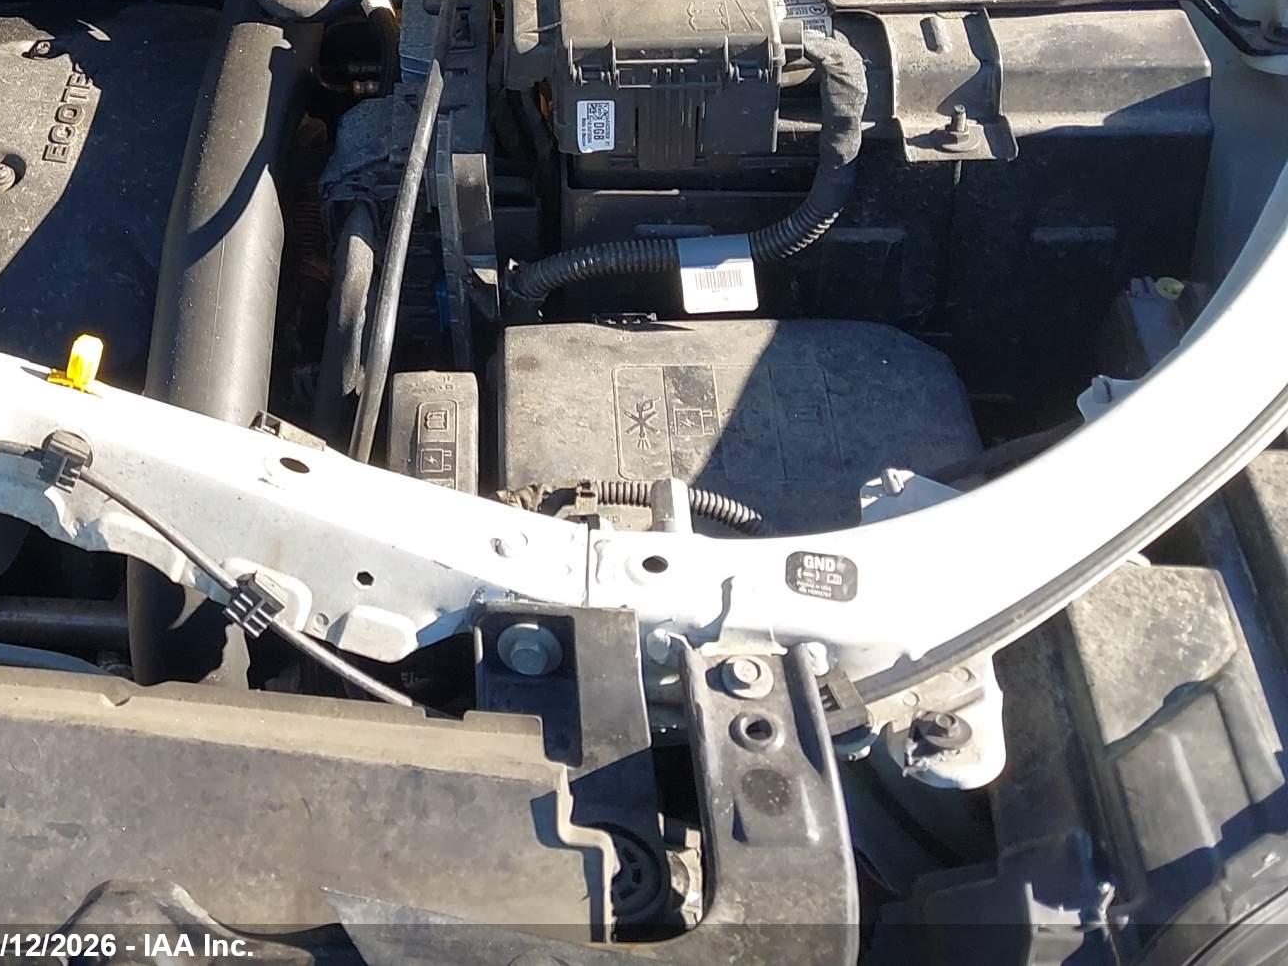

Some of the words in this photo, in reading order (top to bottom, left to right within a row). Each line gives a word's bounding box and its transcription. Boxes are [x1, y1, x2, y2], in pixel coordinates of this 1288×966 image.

[41, 62, 91, 164] ECOTE
[593, 121, 605, 141] DGB
[803, 555, 836, 572] GND
